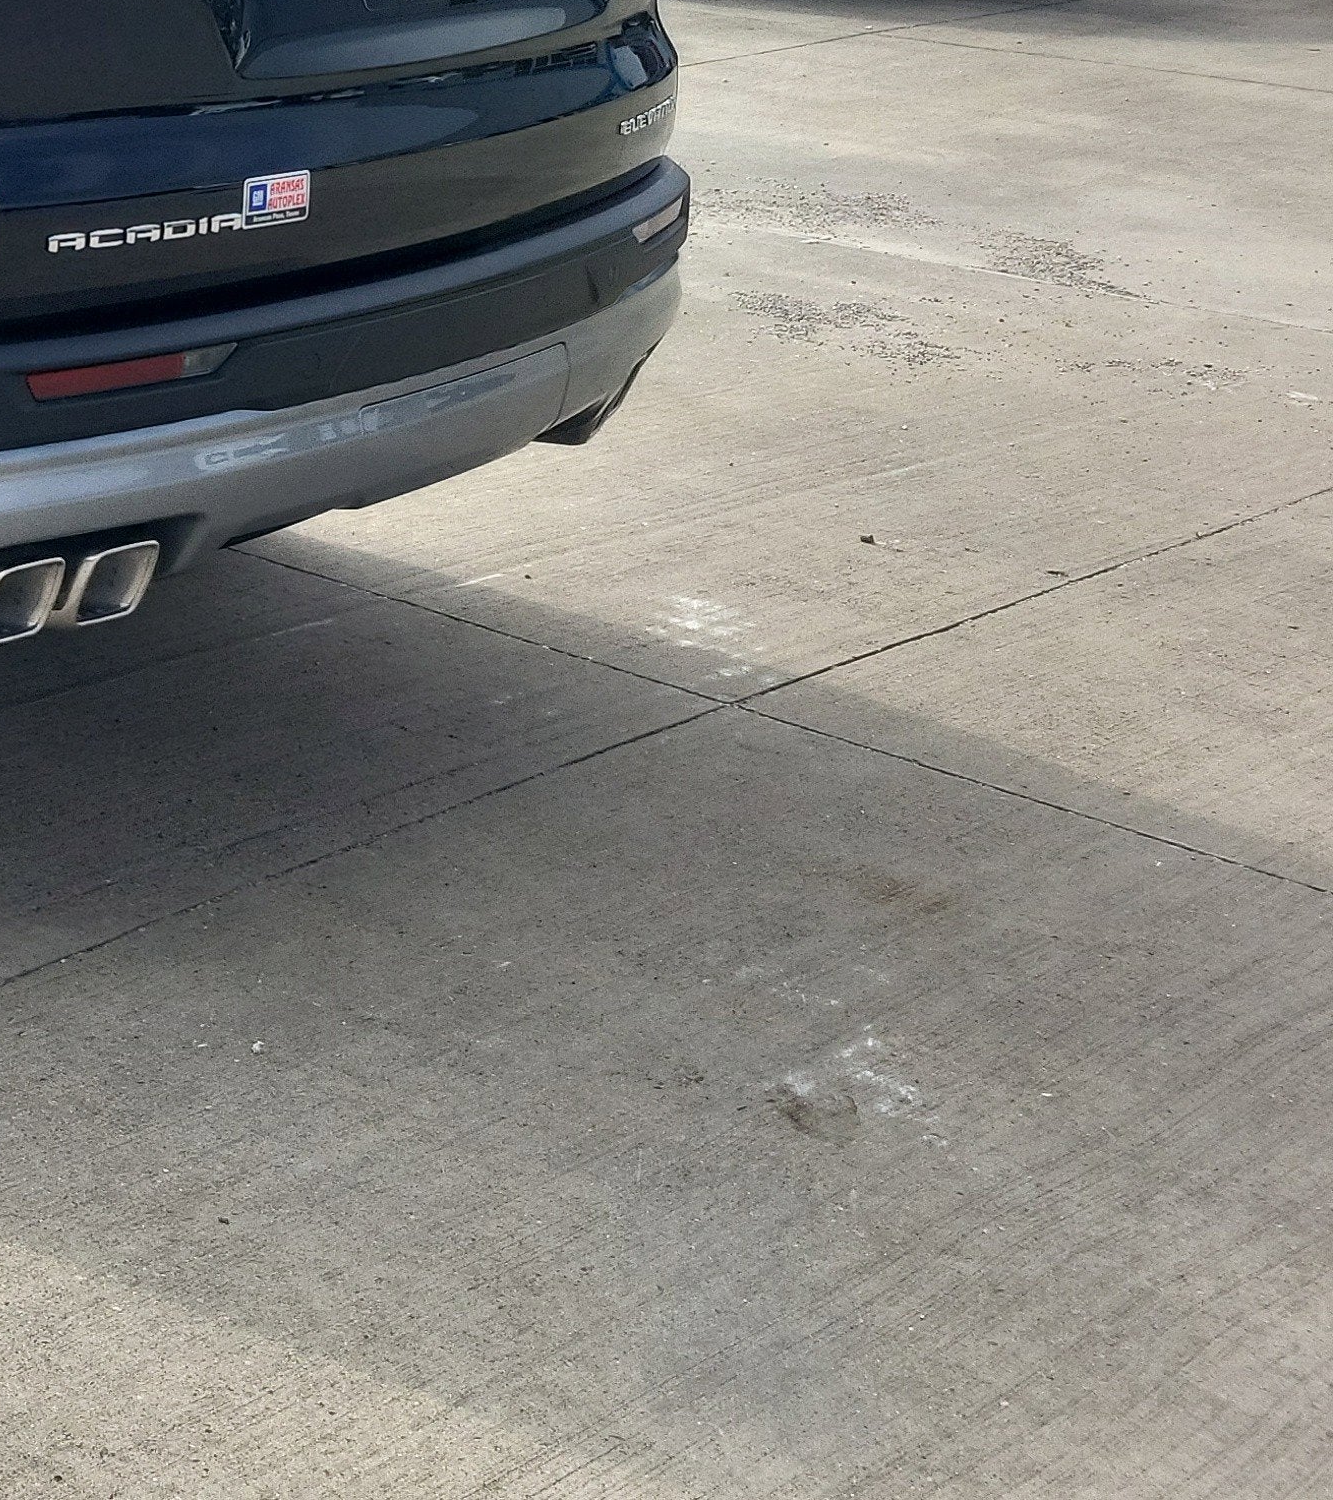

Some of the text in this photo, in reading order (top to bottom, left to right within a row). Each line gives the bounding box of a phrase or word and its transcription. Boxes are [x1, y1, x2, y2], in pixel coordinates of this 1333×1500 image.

[270, 178, 305, 196] ARANSAS
[268, 193, 306, 211] AUTOPLEX
[48, 212, 242, 253] ACADIA
